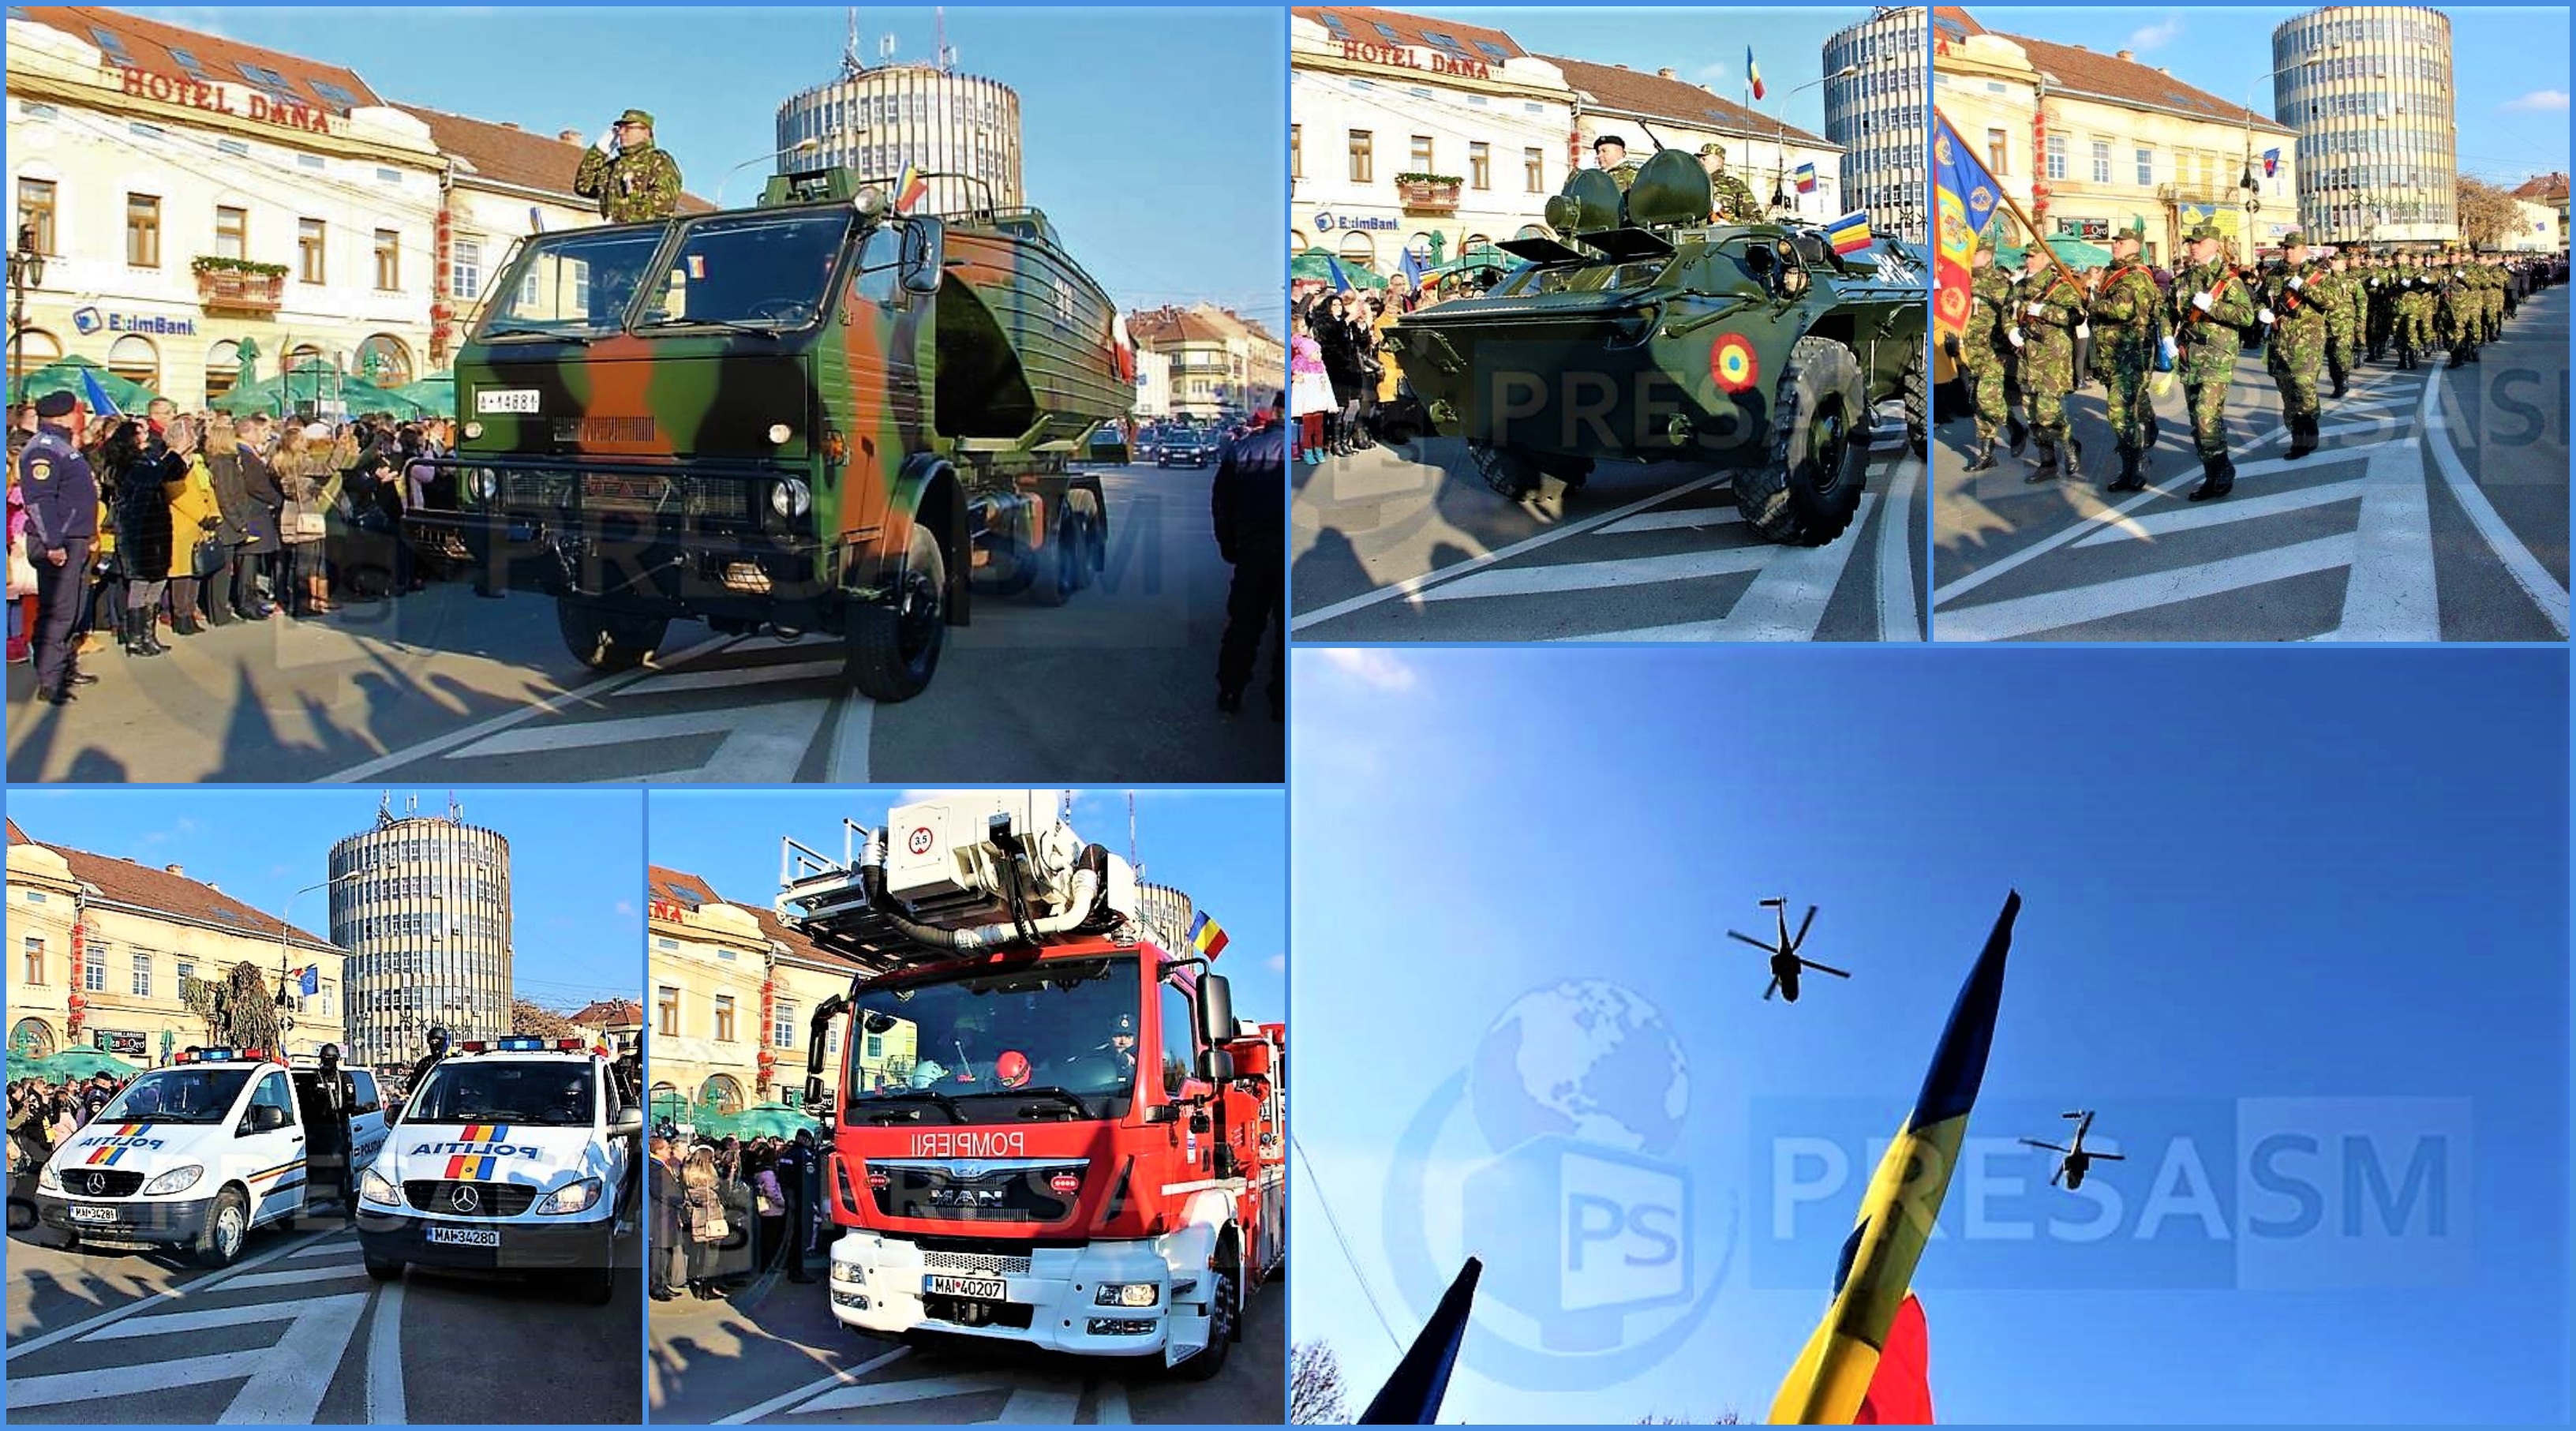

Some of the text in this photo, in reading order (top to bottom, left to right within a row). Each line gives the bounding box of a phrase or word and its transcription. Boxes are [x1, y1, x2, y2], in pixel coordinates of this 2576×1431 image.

[1343, 39, 1489, 78] HOTEL DANA
[122, 66, 329, 133] HOTEL DANA
[930, 1189, 1003, 1207] MAN
